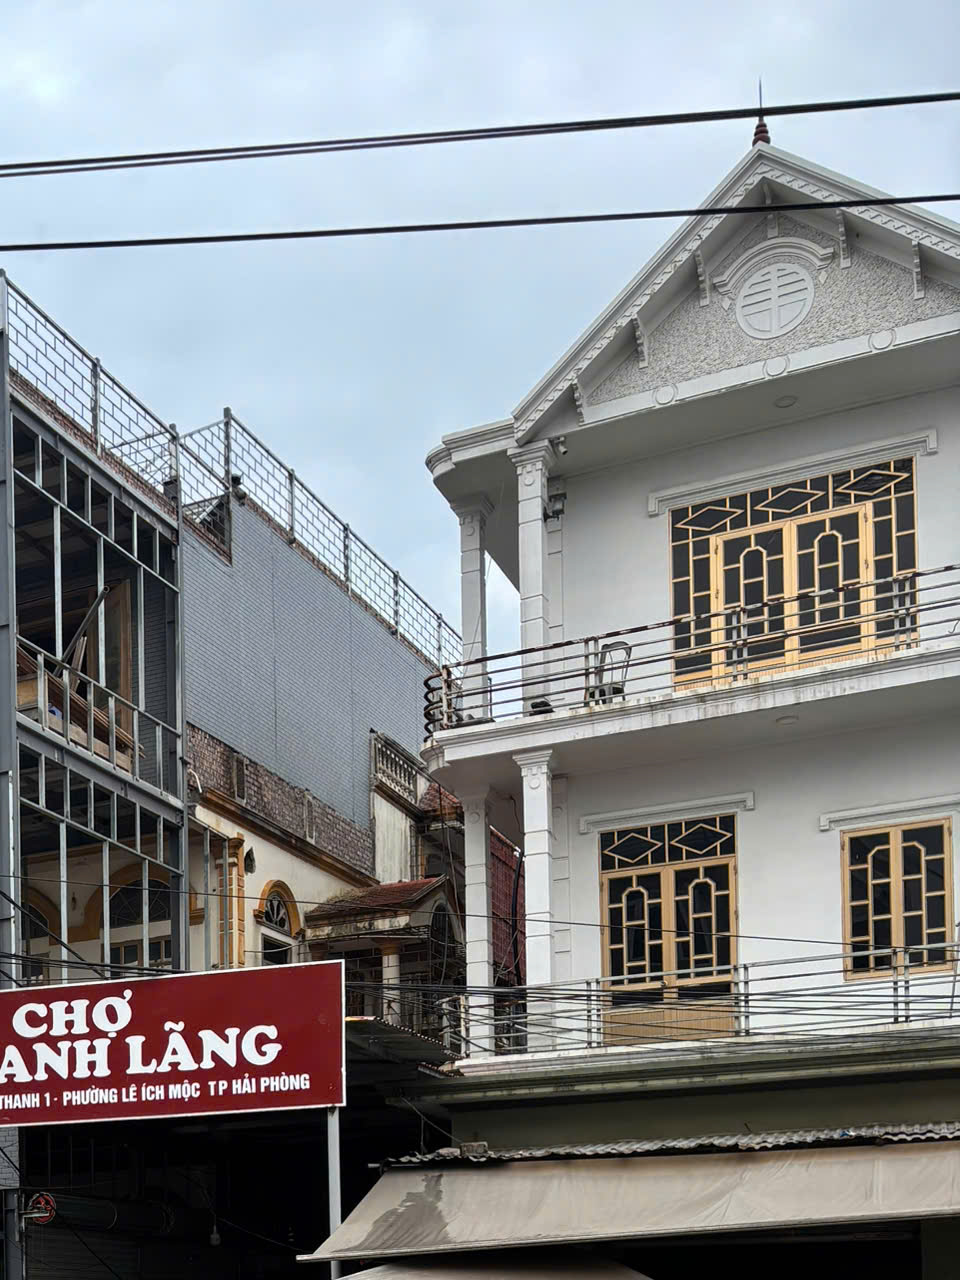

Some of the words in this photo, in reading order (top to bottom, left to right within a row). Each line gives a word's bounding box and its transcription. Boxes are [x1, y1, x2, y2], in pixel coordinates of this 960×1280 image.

[12, 989, 133, 1038] CHỢ
[125, 1021, 282, 1075] LÃNG
[44, 1092, 51, 1108] 1
[62, 1085, 118, 1106] PHƯỜNG
[121, 1084, 138, 1102] LÊ
[141, 1083, 165, 1102] ÍCH
[168, 1079, 201, 1102] MỘC
[232, 1073, 257, 1095] HẢI
[260, 1071, 310, 1093] PHÒNG
